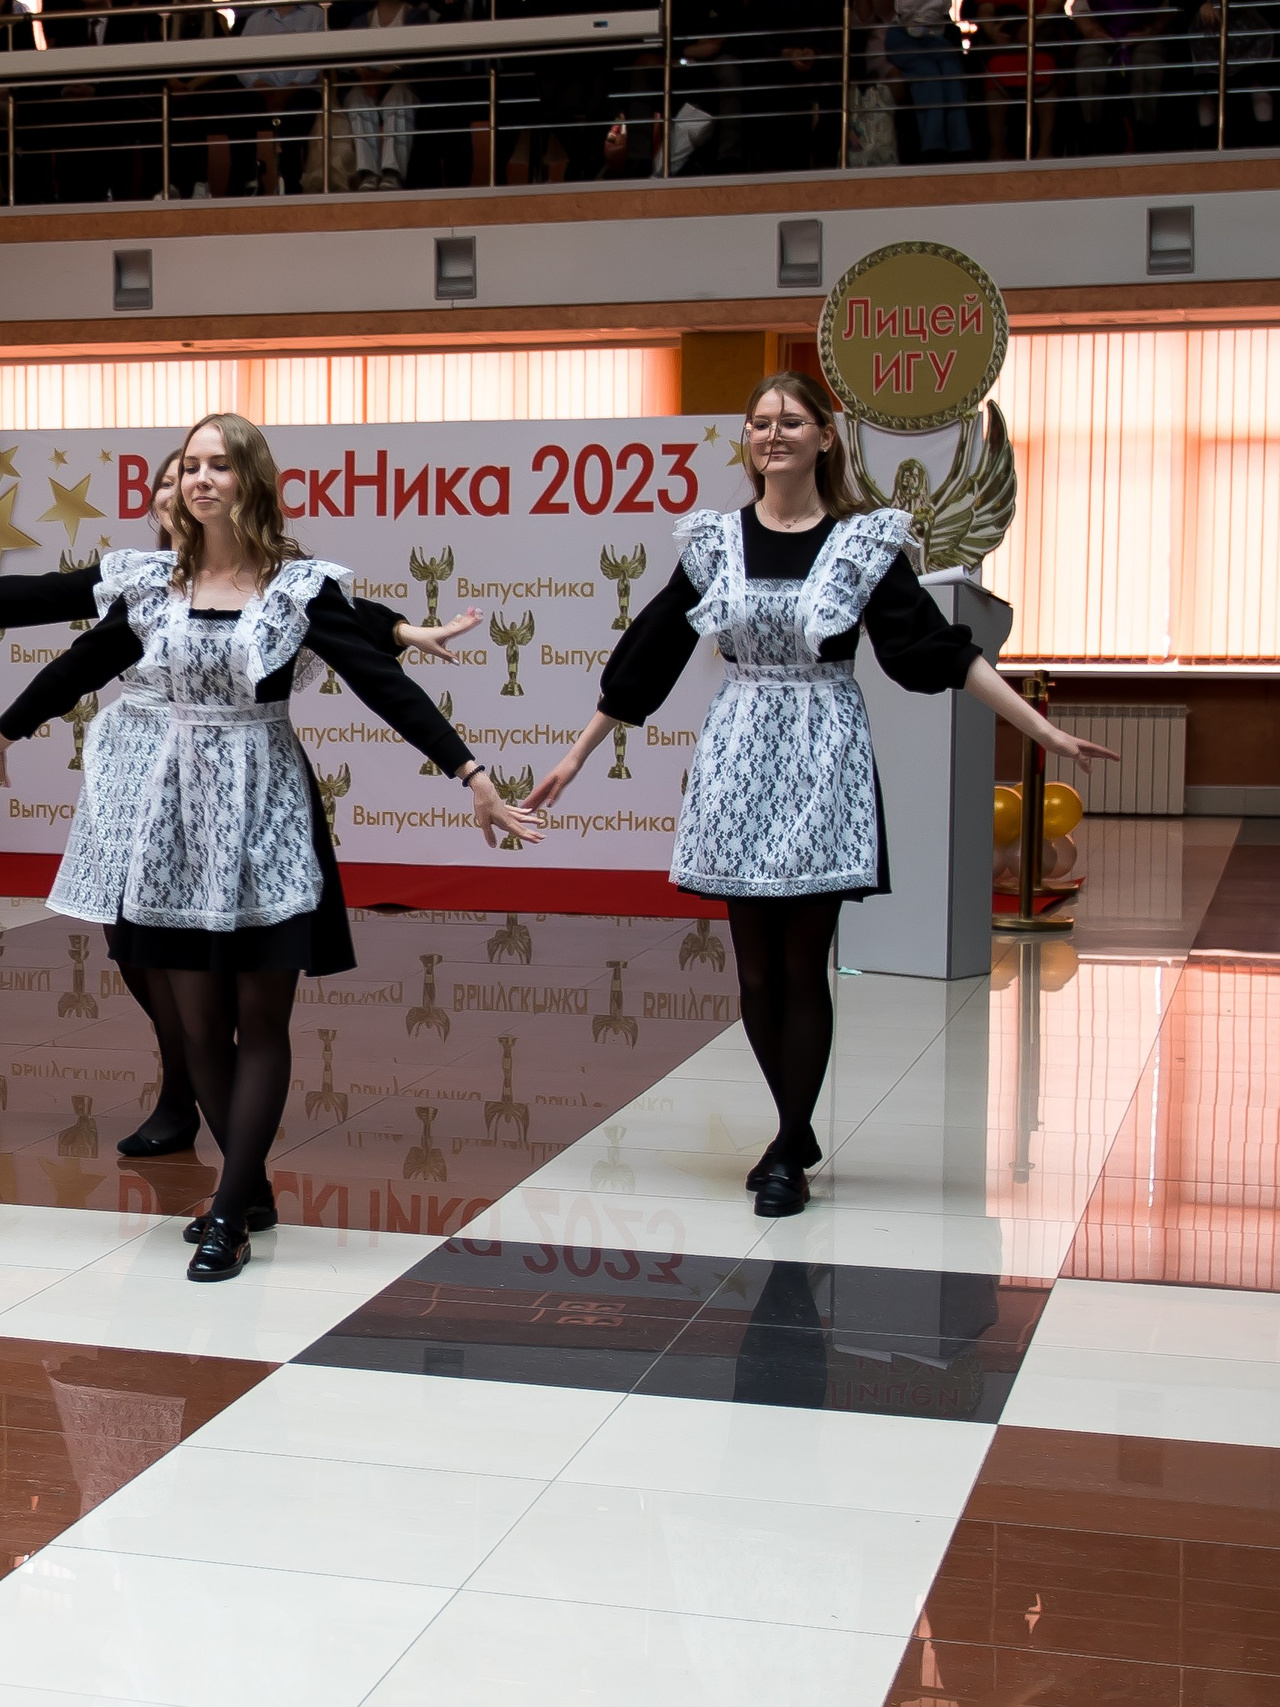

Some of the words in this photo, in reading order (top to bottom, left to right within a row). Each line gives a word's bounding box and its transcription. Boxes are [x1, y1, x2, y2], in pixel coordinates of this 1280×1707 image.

[841, 293, 984, 344] Лицей
[872, 349, 958, 397] ИГУ
[118, 449, 511, 521] ВскНика
[528, 442, 700, 516] 2023
[457, 577, 595, 605] ВыпускНика
[535, 808, 676, 838] ВыпускНика
